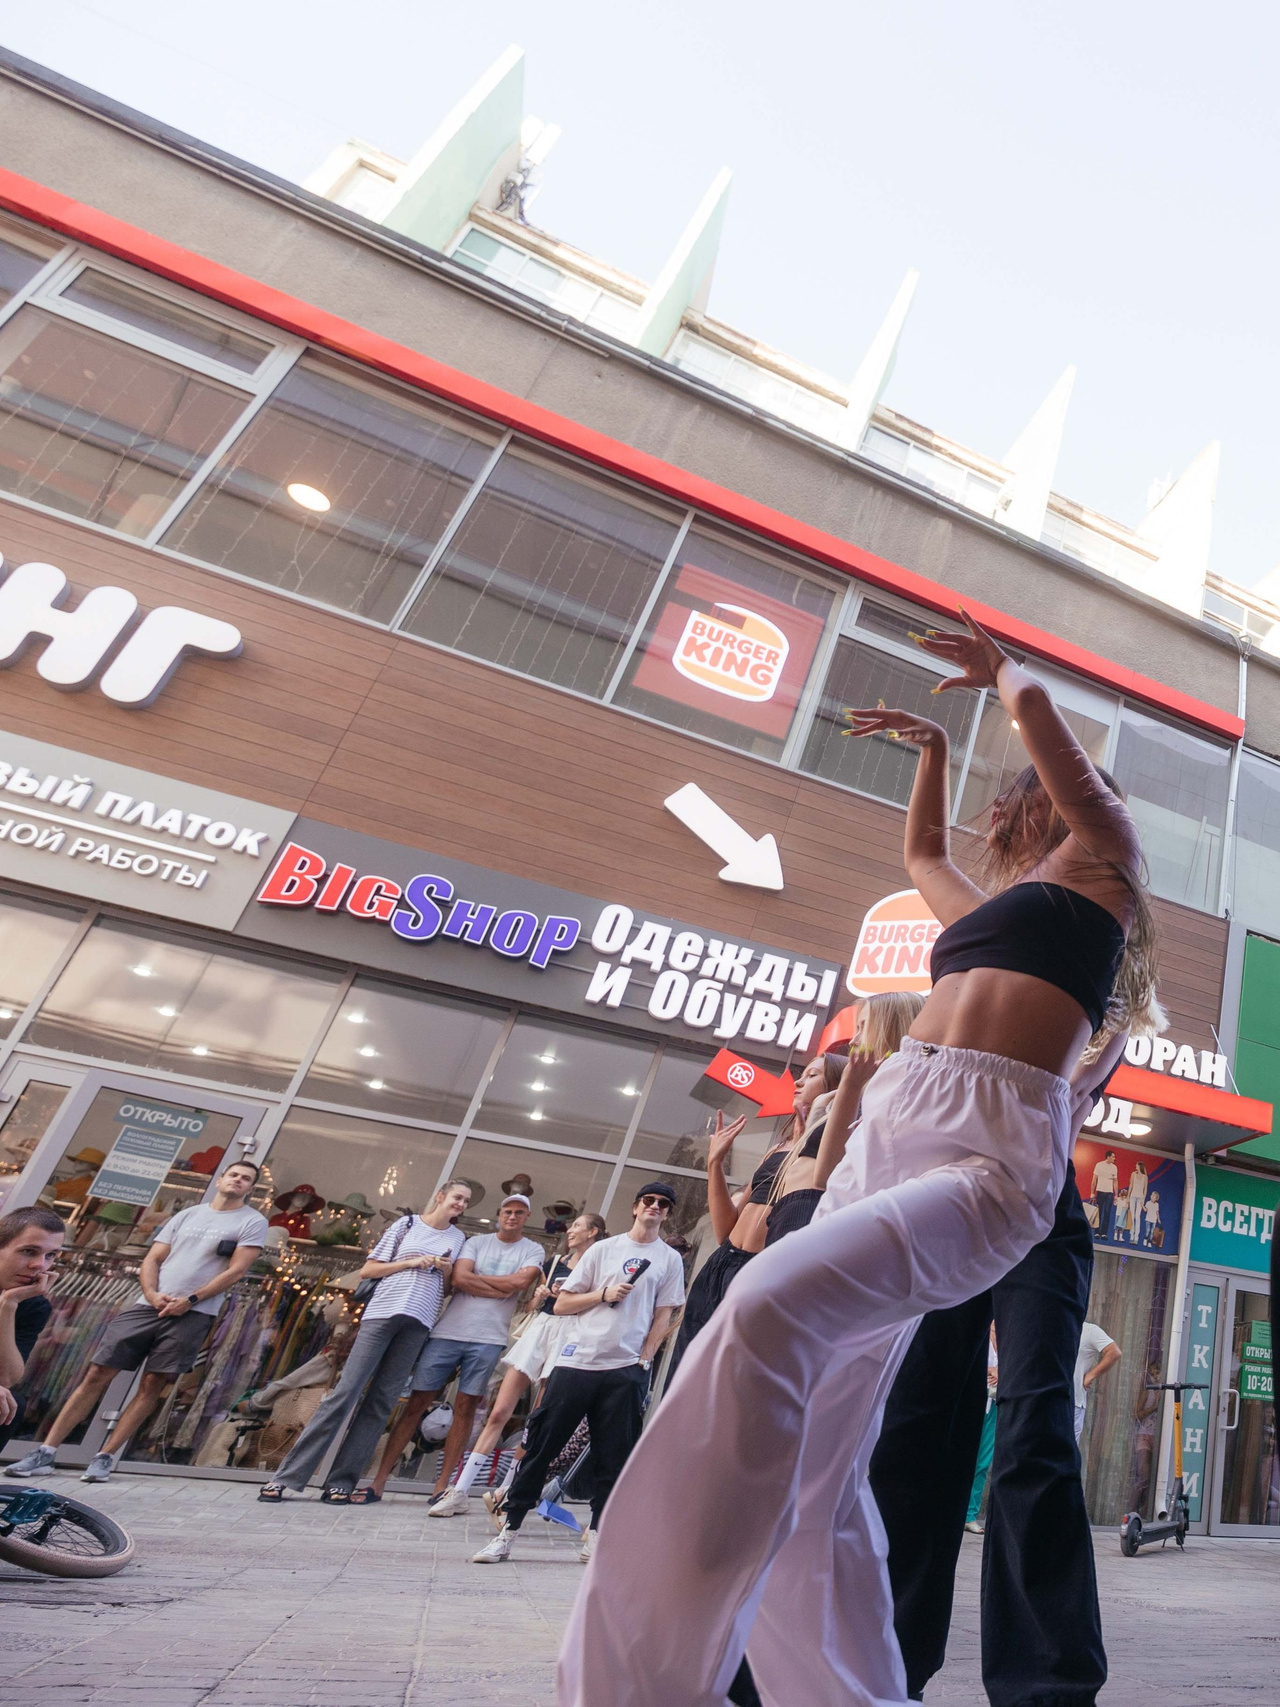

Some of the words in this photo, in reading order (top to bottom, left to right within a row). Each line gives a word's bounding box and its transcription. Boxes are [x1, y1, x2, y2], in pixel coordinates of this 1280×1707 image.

[0, 551, 243, 709] НГ
[690, 620, 780, 667] BURGER
[682, 636, 775, 686] KING
[94, 790, 269, 858] ПЛАТОК
[67, 837, 209, 889] РАБОТЫ
[591, 903, 839, 1008] Одежды
[862, 923, 945, 945] BURGE
[647, 969, 819, 1053] Обуви
[118, 1104, 205, 1133] ОТКРЫТО
